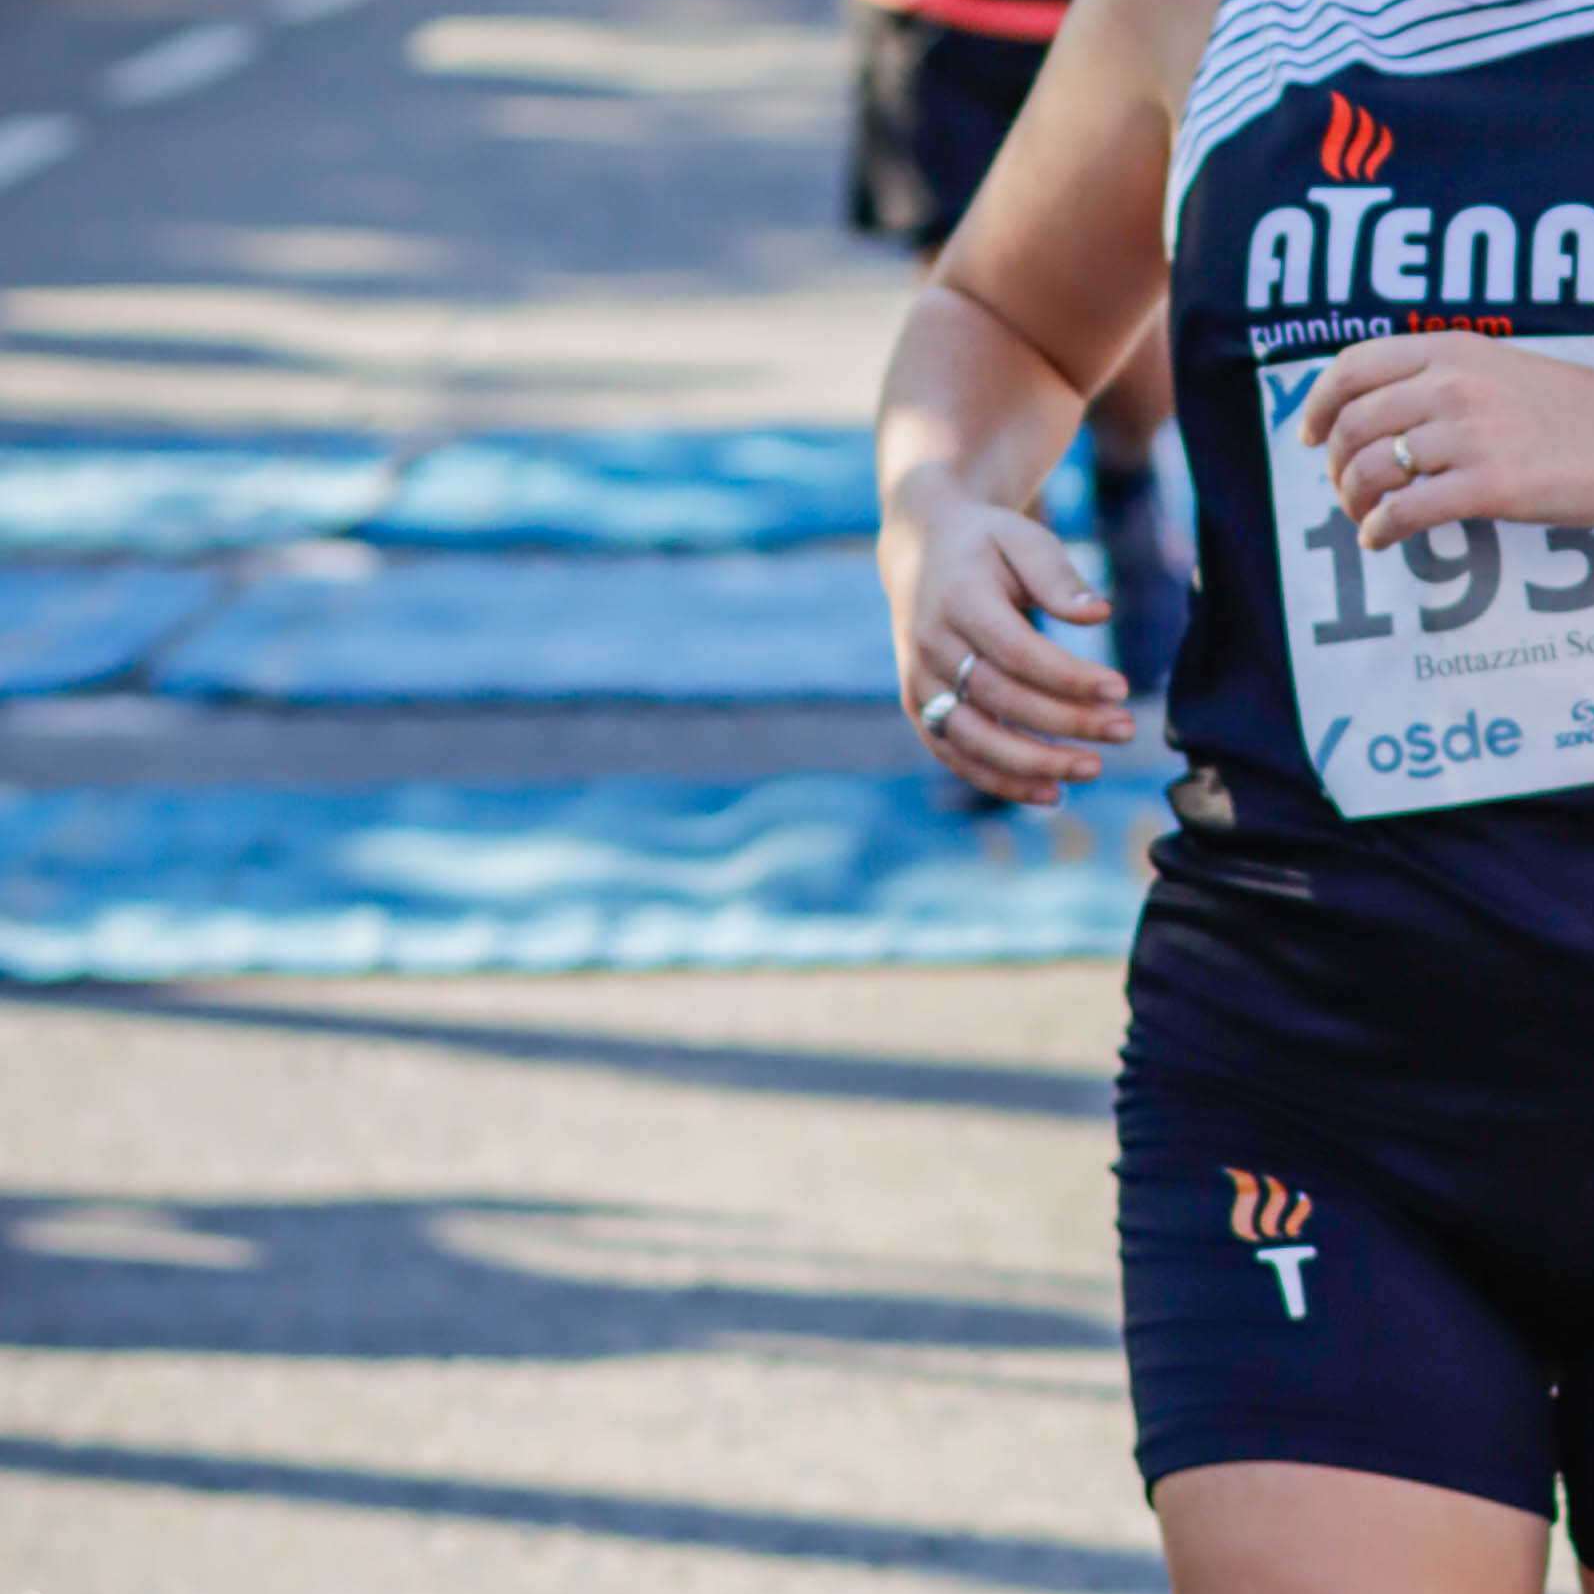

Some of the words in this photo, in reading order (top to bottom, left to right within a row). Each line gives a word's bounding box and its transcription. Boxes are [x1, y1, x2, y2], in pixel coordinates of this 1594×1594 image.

[1250, 310, 1393, 349] running
[1407, 310, 1513, 337] team
[1413, 641, 1557, 681] Bottazzini
[1367, 709, 1523, 775] osde
